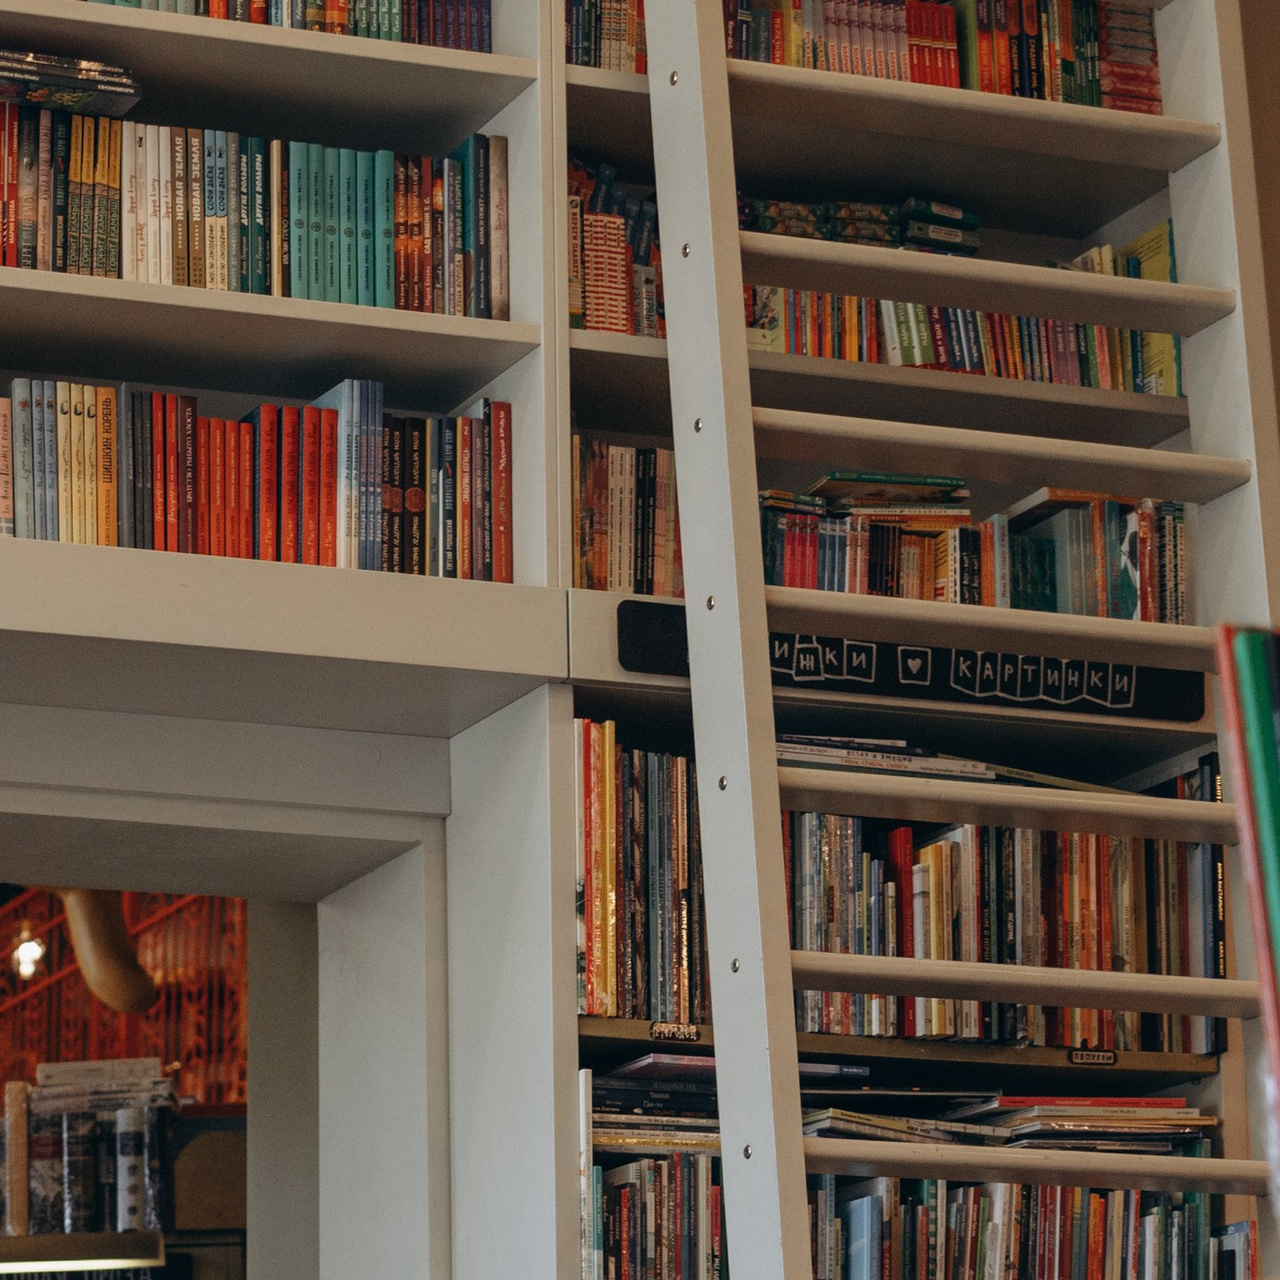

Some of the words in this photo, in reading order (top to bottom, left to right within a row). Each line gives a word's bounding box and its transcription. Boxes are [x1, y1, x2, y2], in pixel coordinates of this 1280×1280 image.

[175, 137, 183, 176] ЗЕМЛЯ
[192, 138, 200, 178] ЗЕМЛЯ
[176, 182, 184, 220] НОВАЯ
[82, 240, 90, 267] ГОРИТ
[97, 398, 112, 434] КОРЕНЬ
[97, 437, 112, 483] ШИШКИН
[185, 469, 193, 502] БРАТСТВО
[959, 660, 1128, 692] КАРТИНКИ
